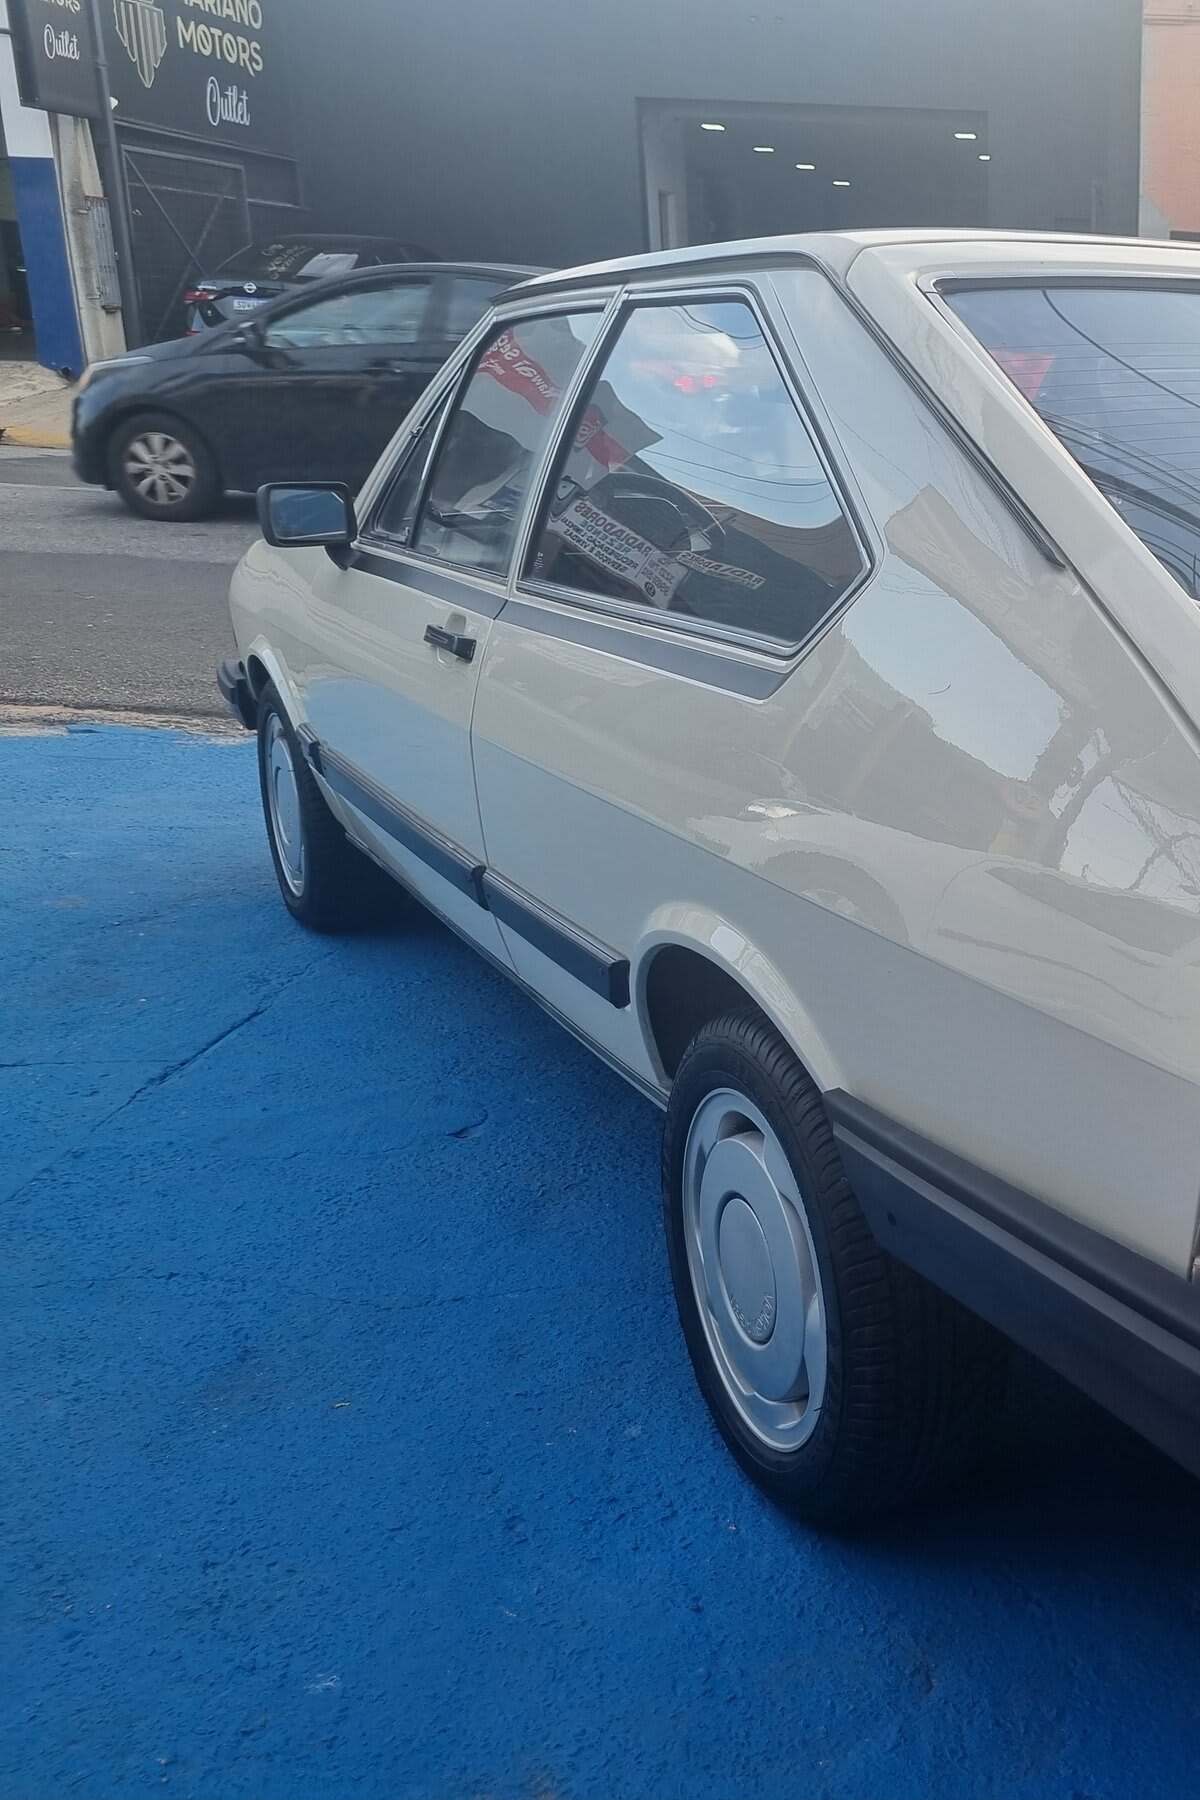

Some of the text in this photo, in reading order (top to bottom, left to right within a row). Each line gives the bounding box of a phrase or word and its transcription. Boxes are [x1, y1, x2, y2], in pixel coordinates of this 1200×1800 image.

[43, 23, 80, 60] Outlet
[176, 15, 264, 77] MOTORS
[206, 76, 251, 126] Outlet
